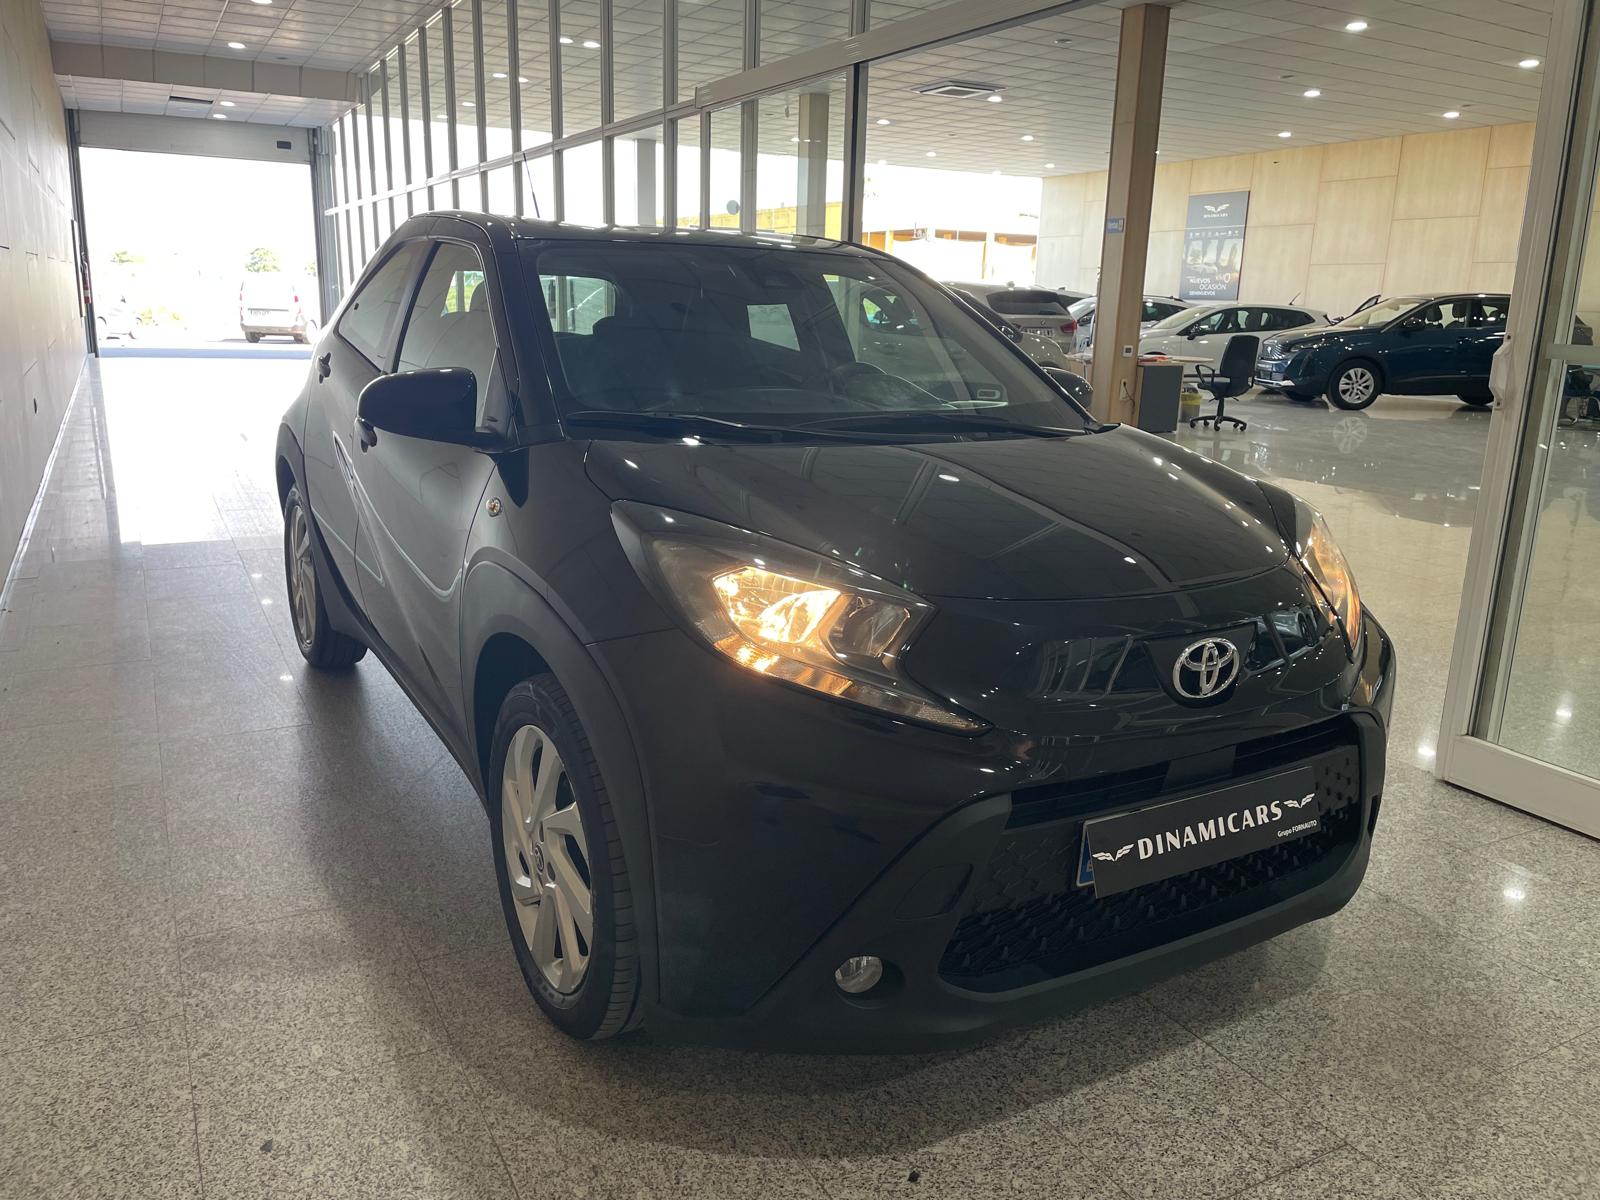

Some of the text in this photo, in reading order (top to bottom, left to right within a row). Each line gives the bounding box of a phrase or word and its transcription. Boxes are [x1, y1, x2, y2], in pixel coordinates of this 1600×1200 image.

[1199, 281, 1227, 290] OCASIÓN
[1137, 800, 1283, 860] DINAMICARS
[1277, 828, 1292, 838] Grupo
